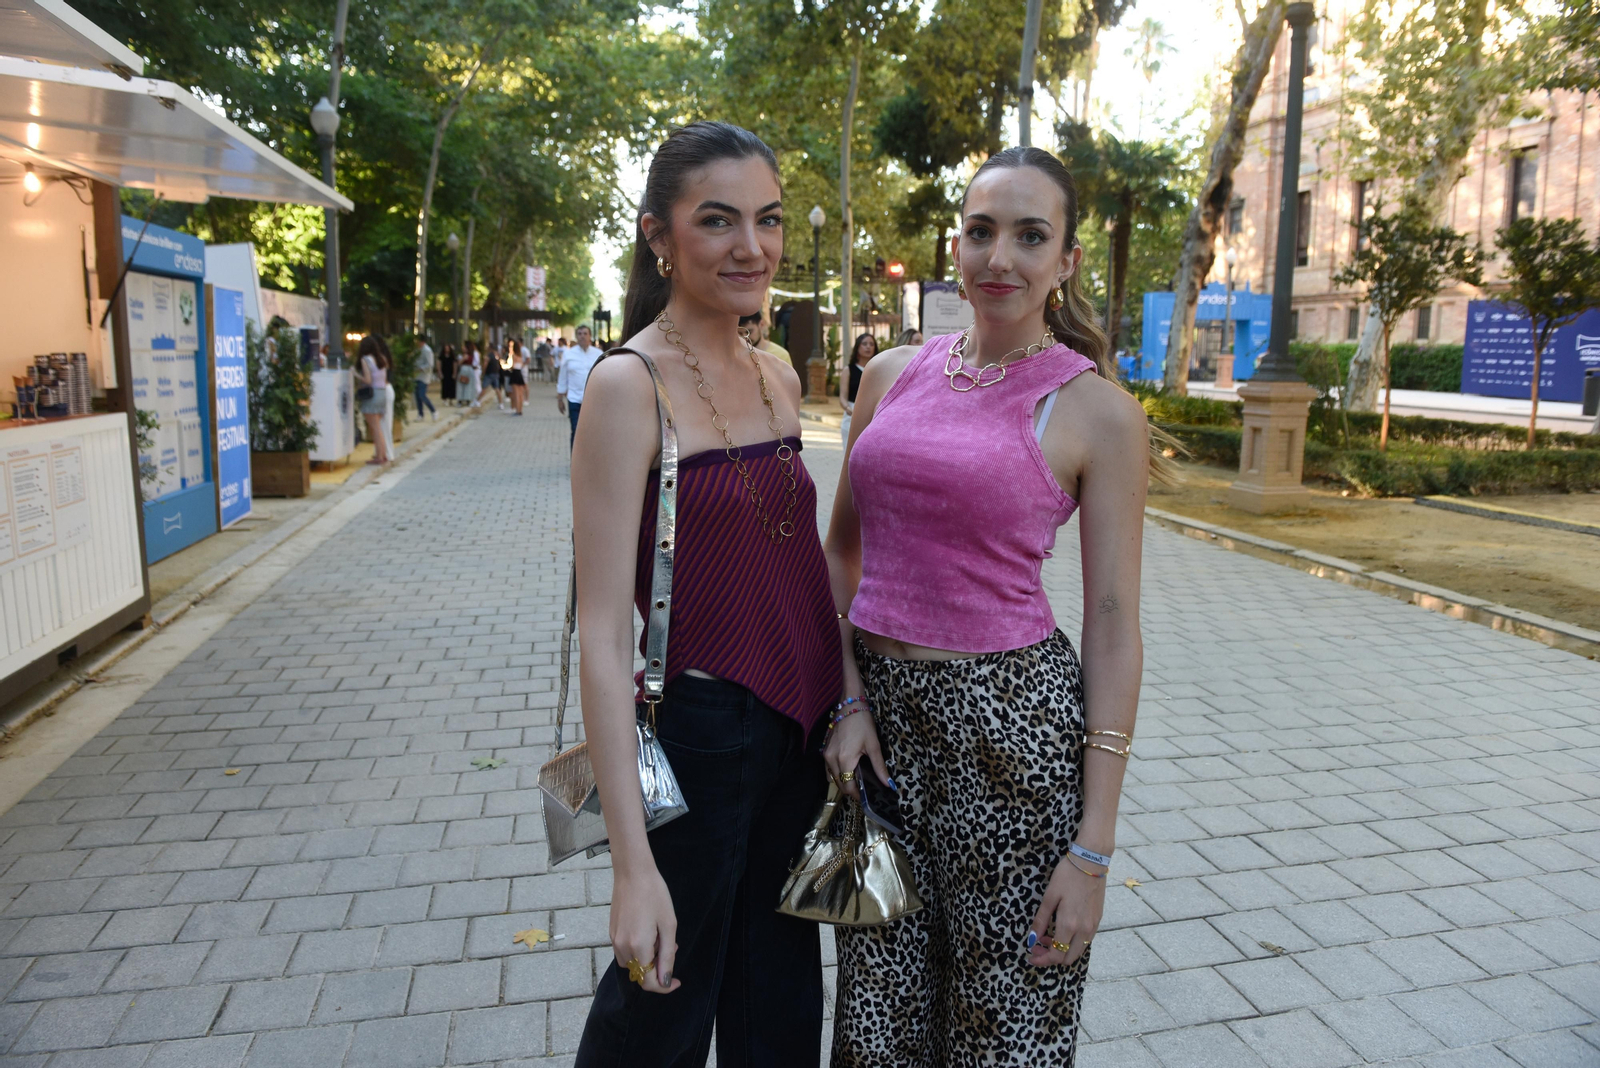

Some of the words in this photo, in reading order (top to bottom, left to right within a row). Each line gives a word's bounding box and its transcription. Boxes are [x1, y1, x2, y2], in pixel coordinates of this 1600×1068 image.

[215, 335, 222, 358] SI
[222, 335, 235, 358] NO
[235, 335, 244, 358] TE
[215, 366, 245, 389] PIERDES
[216, 398, 224, 420] NI
[224, 396, 237, 419] UN
[217, 424, 248, 452] FESTIVAL
